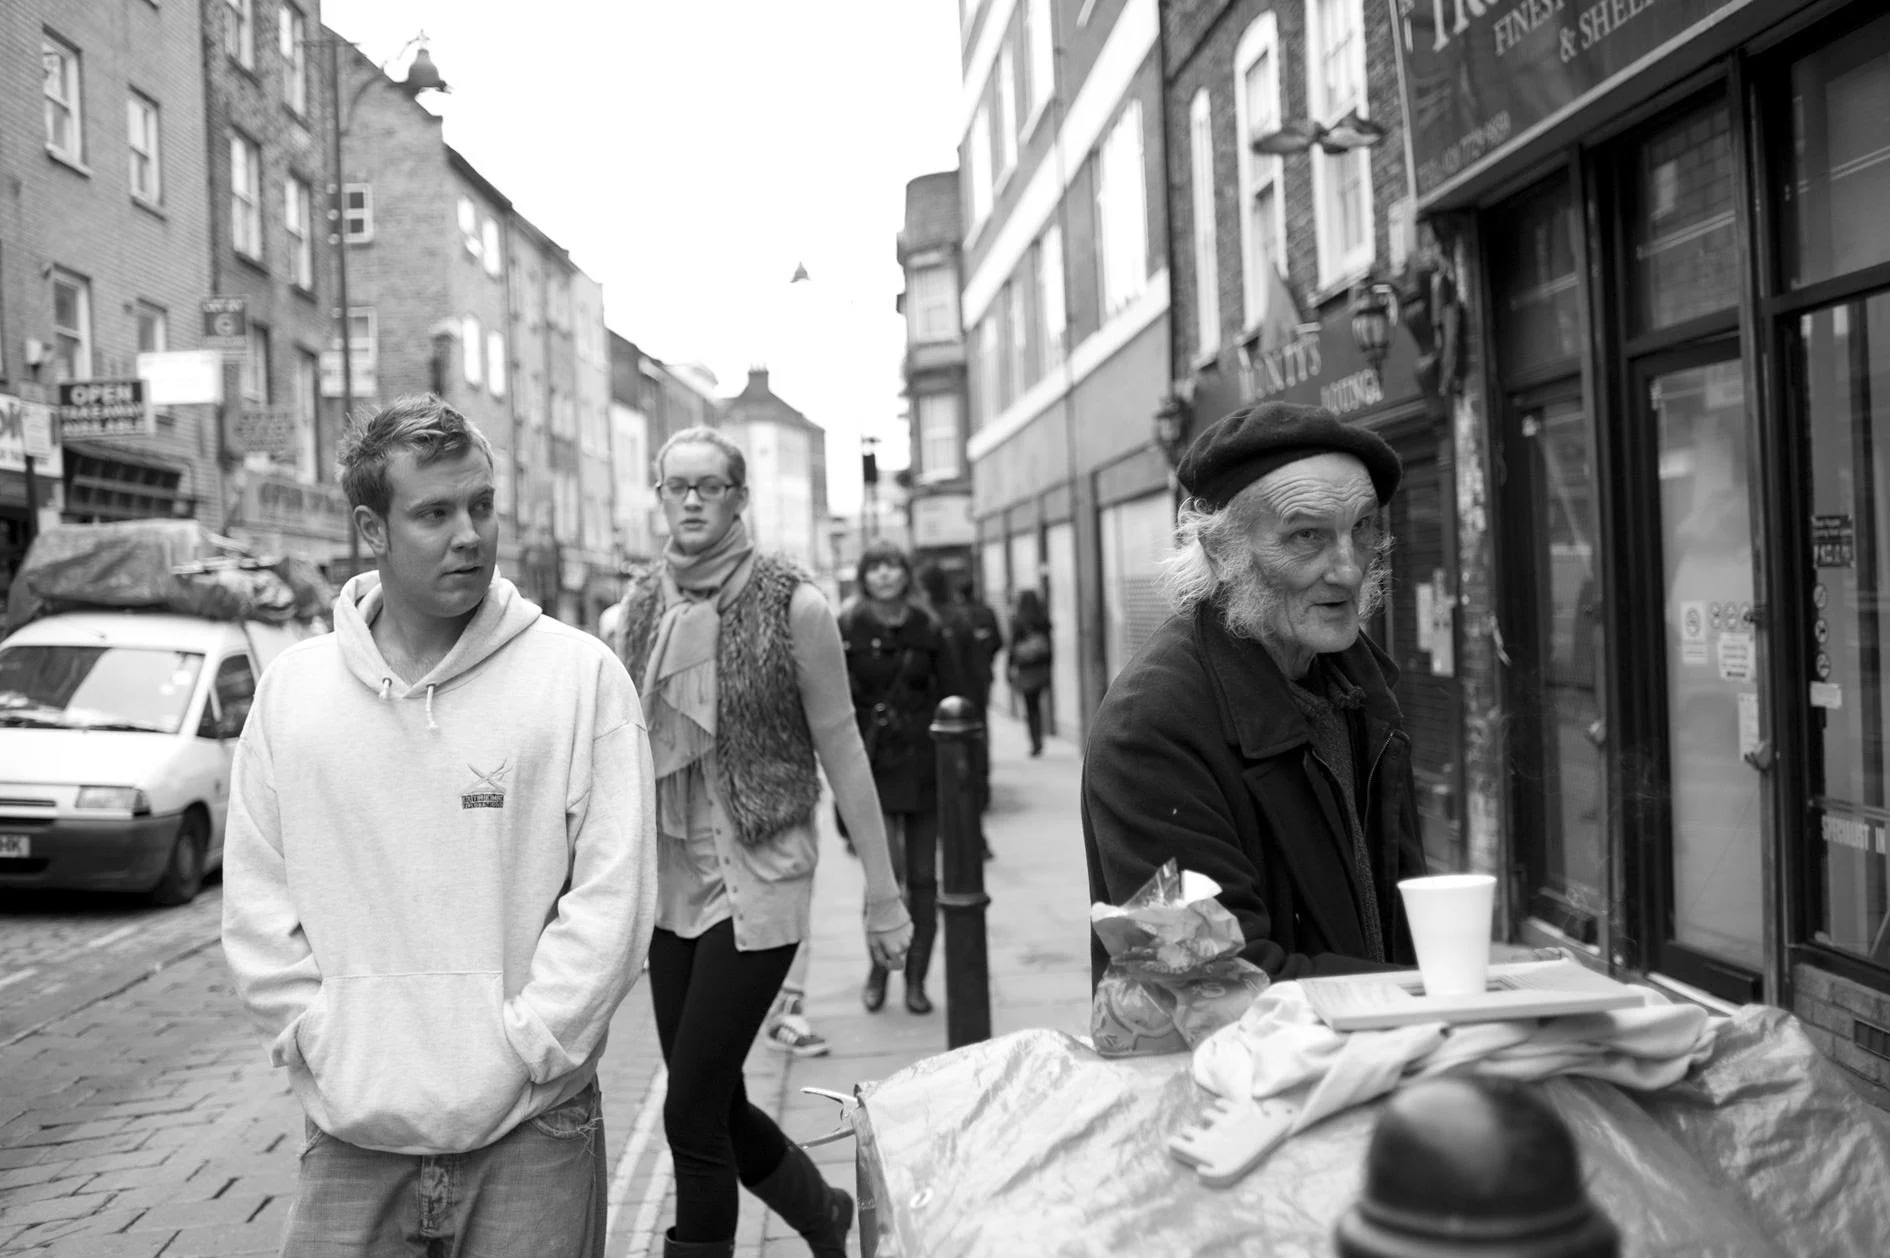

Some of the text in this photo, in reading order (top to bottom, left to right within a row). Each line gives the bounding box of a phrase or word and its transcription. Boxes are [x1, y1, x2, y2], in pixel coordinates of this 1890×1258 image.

[1492, 0, 1565, 56] FINES
[1560, 0, 1655, 62] & SHEL
[70, 384, 132, 407] OPEN
